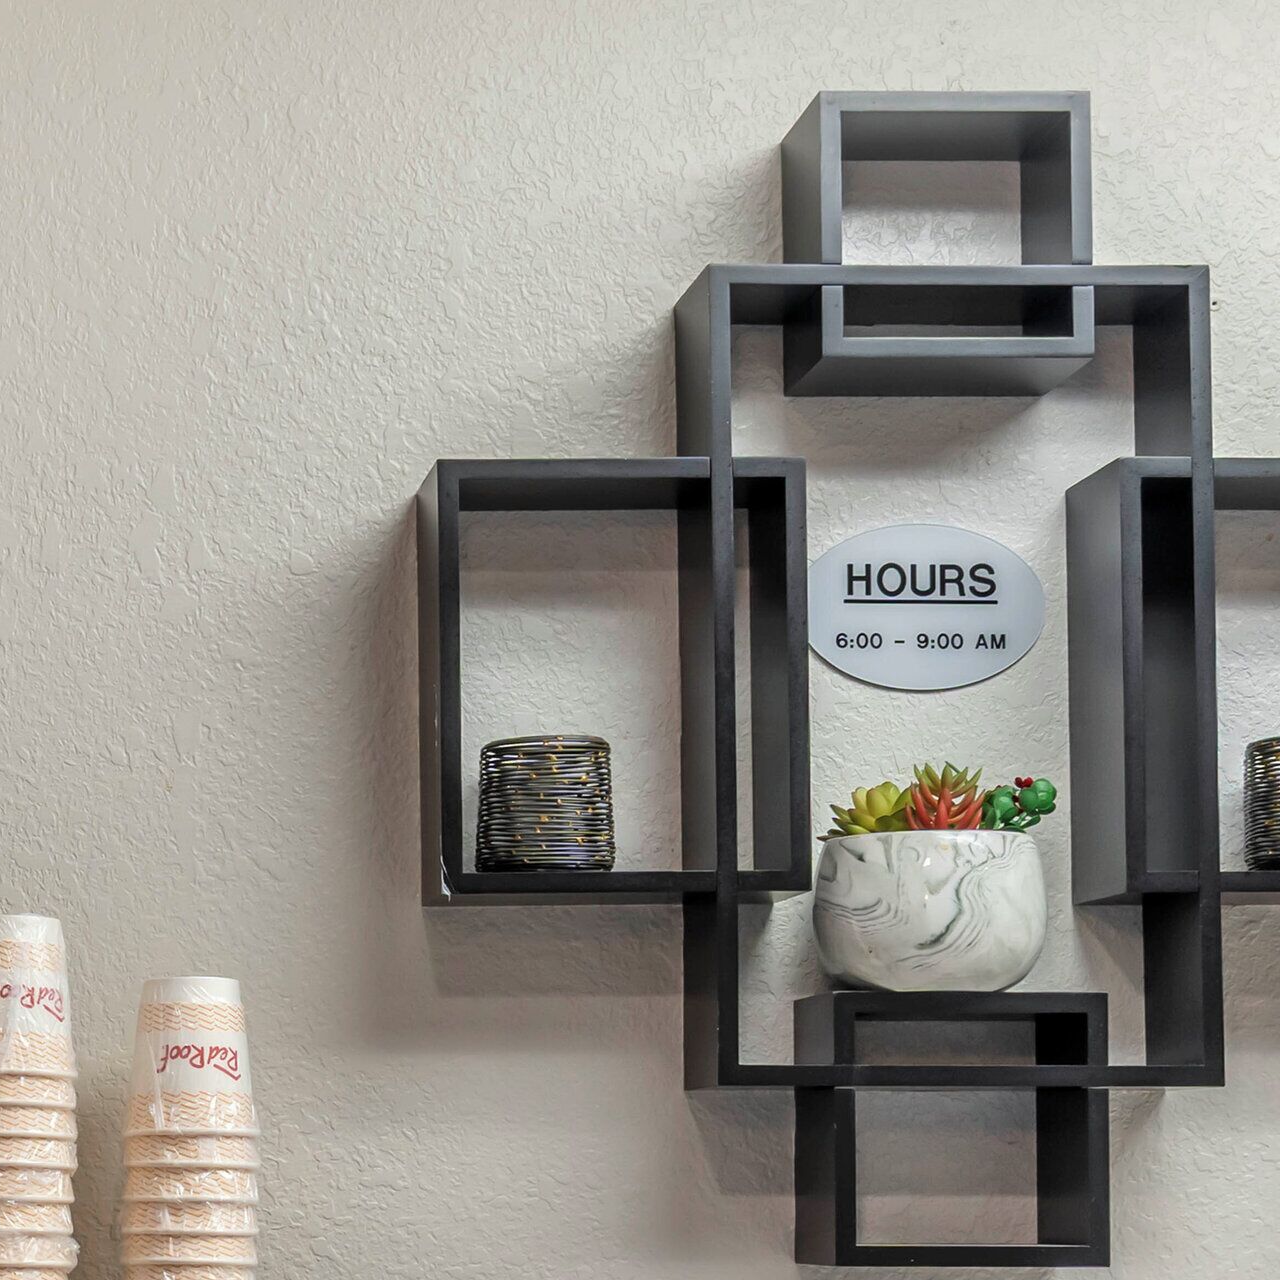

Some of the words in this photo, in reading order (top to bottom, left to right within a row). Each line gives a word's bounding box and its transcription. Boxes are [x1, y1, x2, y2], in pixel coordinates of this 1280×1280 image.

[846, 562, 997, 598] HOURS
[835, 632, 883, 650] 6:00
[916, 633, 964, 650] 9:00
[975, 633, 1006, 650] AM
